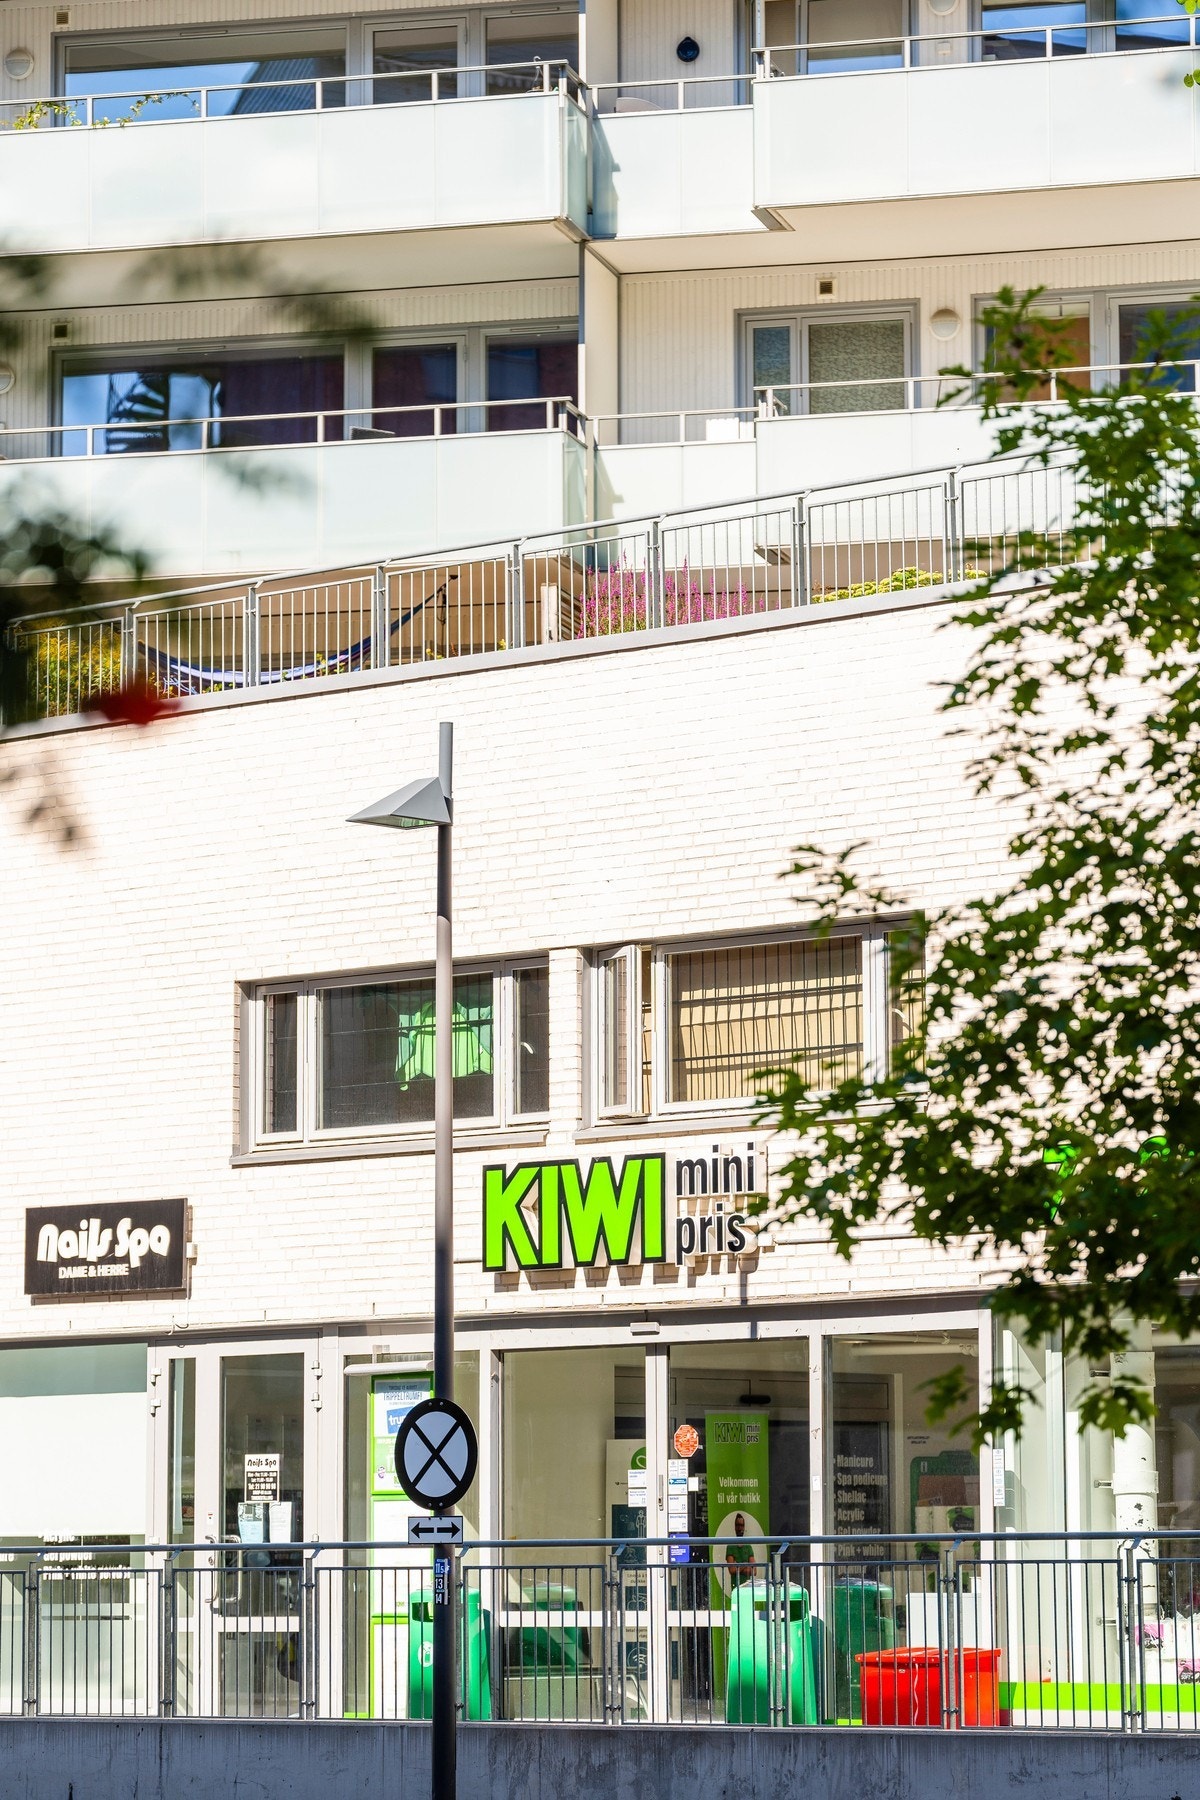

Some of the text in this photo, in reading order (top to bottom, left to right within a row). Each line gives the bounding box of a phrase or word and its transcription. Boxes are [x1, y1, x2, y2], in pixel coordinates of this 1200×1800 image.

[482, 1143, 755, 1272] KIWI mini
[676, 1202, 746, 1265] pris
[114, 1217, 171, 1268] Spa
[58, 1263, 129, 1279] DAME & HERRE
[714, 1422, 745, 1443] KIWI
[836, 1455, 874, 1468] Manicure
[719, 1477, 758, 1487] Velkommen
[837, 1473, 888, 1486] Spa pedicure
[717, 1492, 761, 1504] til vår butikk
[837, 1490, 867, 1503] Shellac
[837, 1508, 865, 1522] Acrylic
[838, 1544, 856, 1557] Pink
[862, 1544, 885, 1557] white
[435, 1578, 443, 1589] 13
